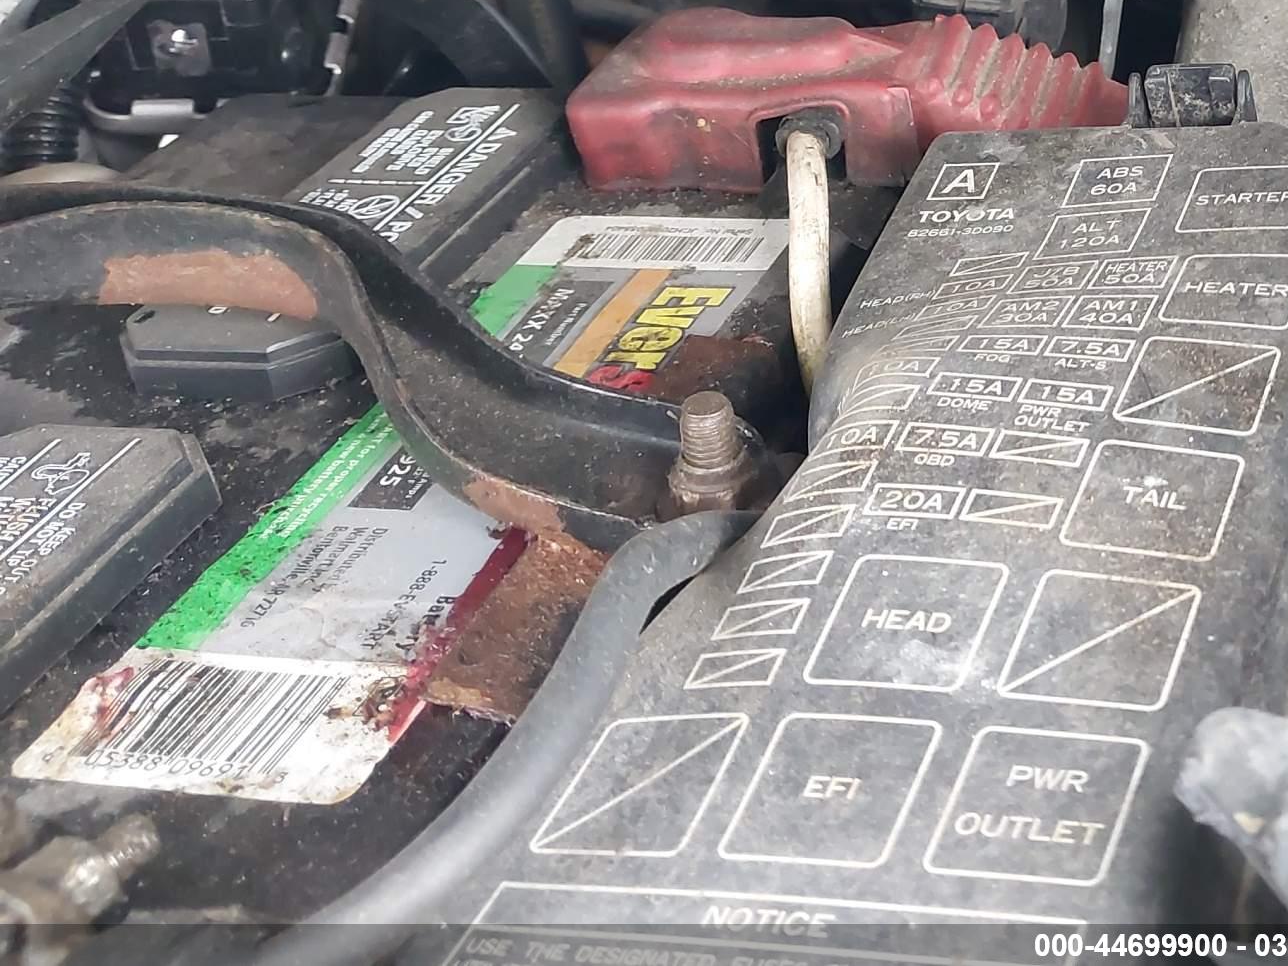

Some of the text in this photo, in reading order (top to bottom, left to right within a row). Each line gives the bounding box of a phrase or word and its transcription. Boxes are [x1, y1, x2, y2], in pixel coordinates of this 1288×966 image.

[413, 143, 503, 206] DANGER
[942, 166, 977, 193] A
[1096, 166, 1145, 179] ABS
[1090, 182, 1138, 195] 60A
[918, 208, 1015, 224] TOYOTA
[1071, 220, 1122, 234] ALT
[1060, 234, 1120, 250] 120A
[1106, 261, 1168, 273] HEATER
[951, 279, 997, 294] 10A
[1023, 276, 1074, 289] 50A
[1104, 273, 1156, 285] 50A
[859, 289, 936, 309] HEAD(RH)
[932, 299, 978, 315] 10A
[1001, 300, 1060, 313] AM2
[1083, 300, 1139, 312] AM1
[993, 312, 1048, 324] 30A
[1078, 312, 1135, 325] 40A
[979, 338, 1030, 351] 15A
[1060, 341, 1123, 356] 7.5A
[973, 353, 1010, 363] FOG
[952, 378, 1004, 393] 15A
[1041, 385, 1095, 404] 15A
[937, 397, 992, 411] DOME
[1019, 406, 1062, 416] PWR
[1013, 415, 1090, 432] OUTLET
[827, 426, 877, 448] 10A
[913, 430, 977, 449] 7.5A
[913, 454, 955, 467] OBD
[880, 491, 943, 511] 20A
[1124, 485, 1188, 510] TAIL
[886, 518, 919, 531] EFI
[6, 501, 87, 566] DO NOT TIP
[37, 526, 76, 556] KEEP
[316, 526, 370, 569] Walmart
[334, 527, 388, 584] Distributed
[861, 607, 953, 636] HEAD
[1005, 765, 1088, 794] PWR
[801, 774, 861, 802] EFI
[953, 811, 1105, 848] OUTLET
[702, 904, 837, 939] NOTICE
[464, 936, 513, 957] USE
[523, 942, 570, 963] THE
[574, 945, 716, 966] DESIGNATED
